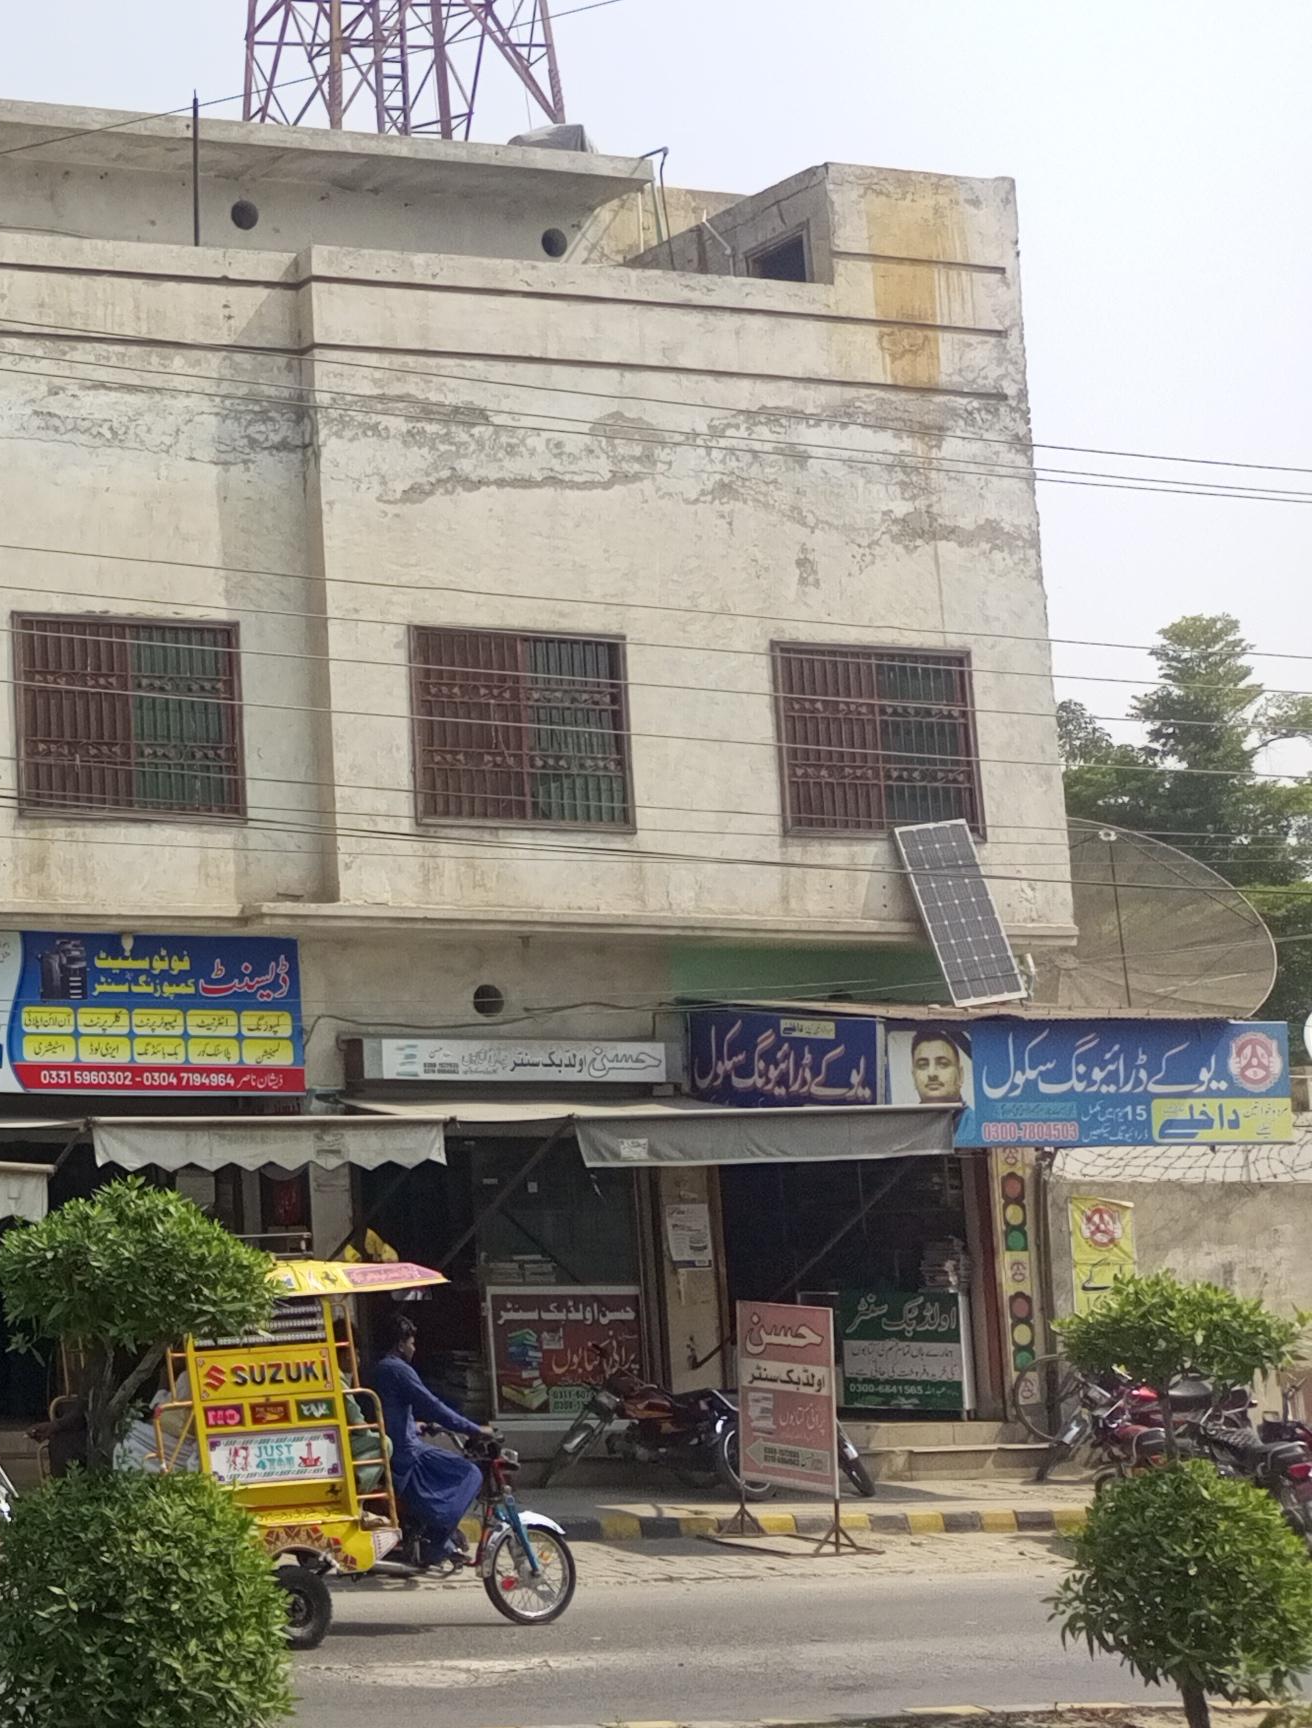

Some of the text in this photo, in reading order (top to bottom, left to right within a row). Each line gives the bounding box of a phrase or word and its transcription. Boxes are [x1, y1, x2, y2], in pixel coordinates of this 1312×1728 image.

[92, 976, 130, 997] سنٹر
[199, 955, 290, 1001] ڈیسنٹ
[588, 1046, 663, 1078] حسن
[694, 1019, 746, 1089] سکول
[731, 1028, 814, 1096] ڈرائیونگ
[982, 1028, 1229, 1099] یو کے ڈرائیونگ سکول
[41, 1069, 71, 1084] 0331
[75, 1070, 133, 1085] 5960302
[181, 1072, 235, 1086] 7194964
[1126, 1104, 1148, 1121] 15
[1158, 1102, 1241, 1140] داخلے
[599, 1306, 636, 1325] حسن
[746, 1312, 824, 1355] حسن
[231, 1360, 328, 1387] SUZUKI
[254, 1444, 294, 1459] JUST
